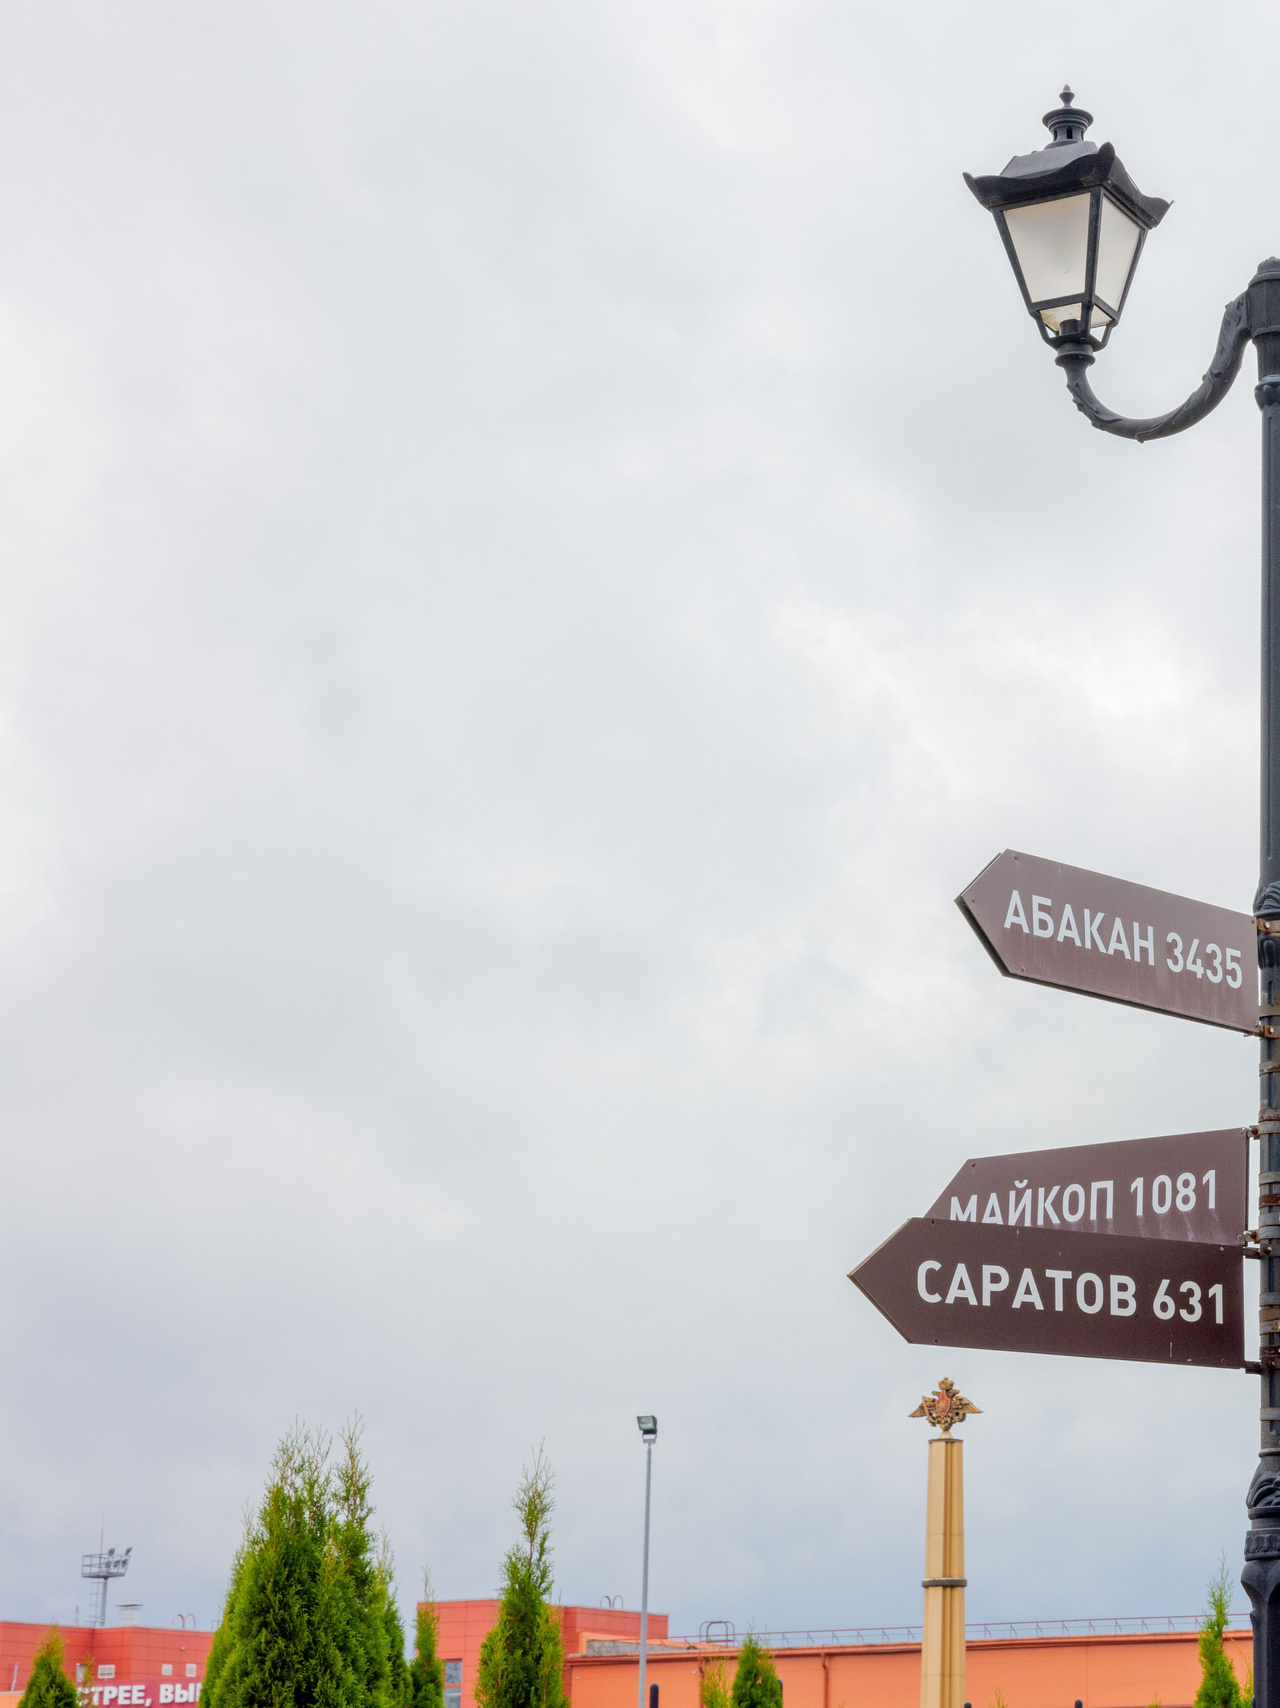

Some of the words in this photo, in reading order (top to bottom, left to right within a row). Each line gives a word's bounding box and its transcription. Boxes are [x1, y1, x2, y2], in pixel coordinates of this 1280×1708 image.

[1003, 889, 1155, 966] АБАКАН
[1166, 931, 1243, 989] 3435
[950, 1179, 1114, 1227] МАЙКОП
[1130, 1169, 1216, 1217] 1081
[916, 1260, 1137, 1317] САРАТОВ
[1152, 1278, 1224, 1325] 631
